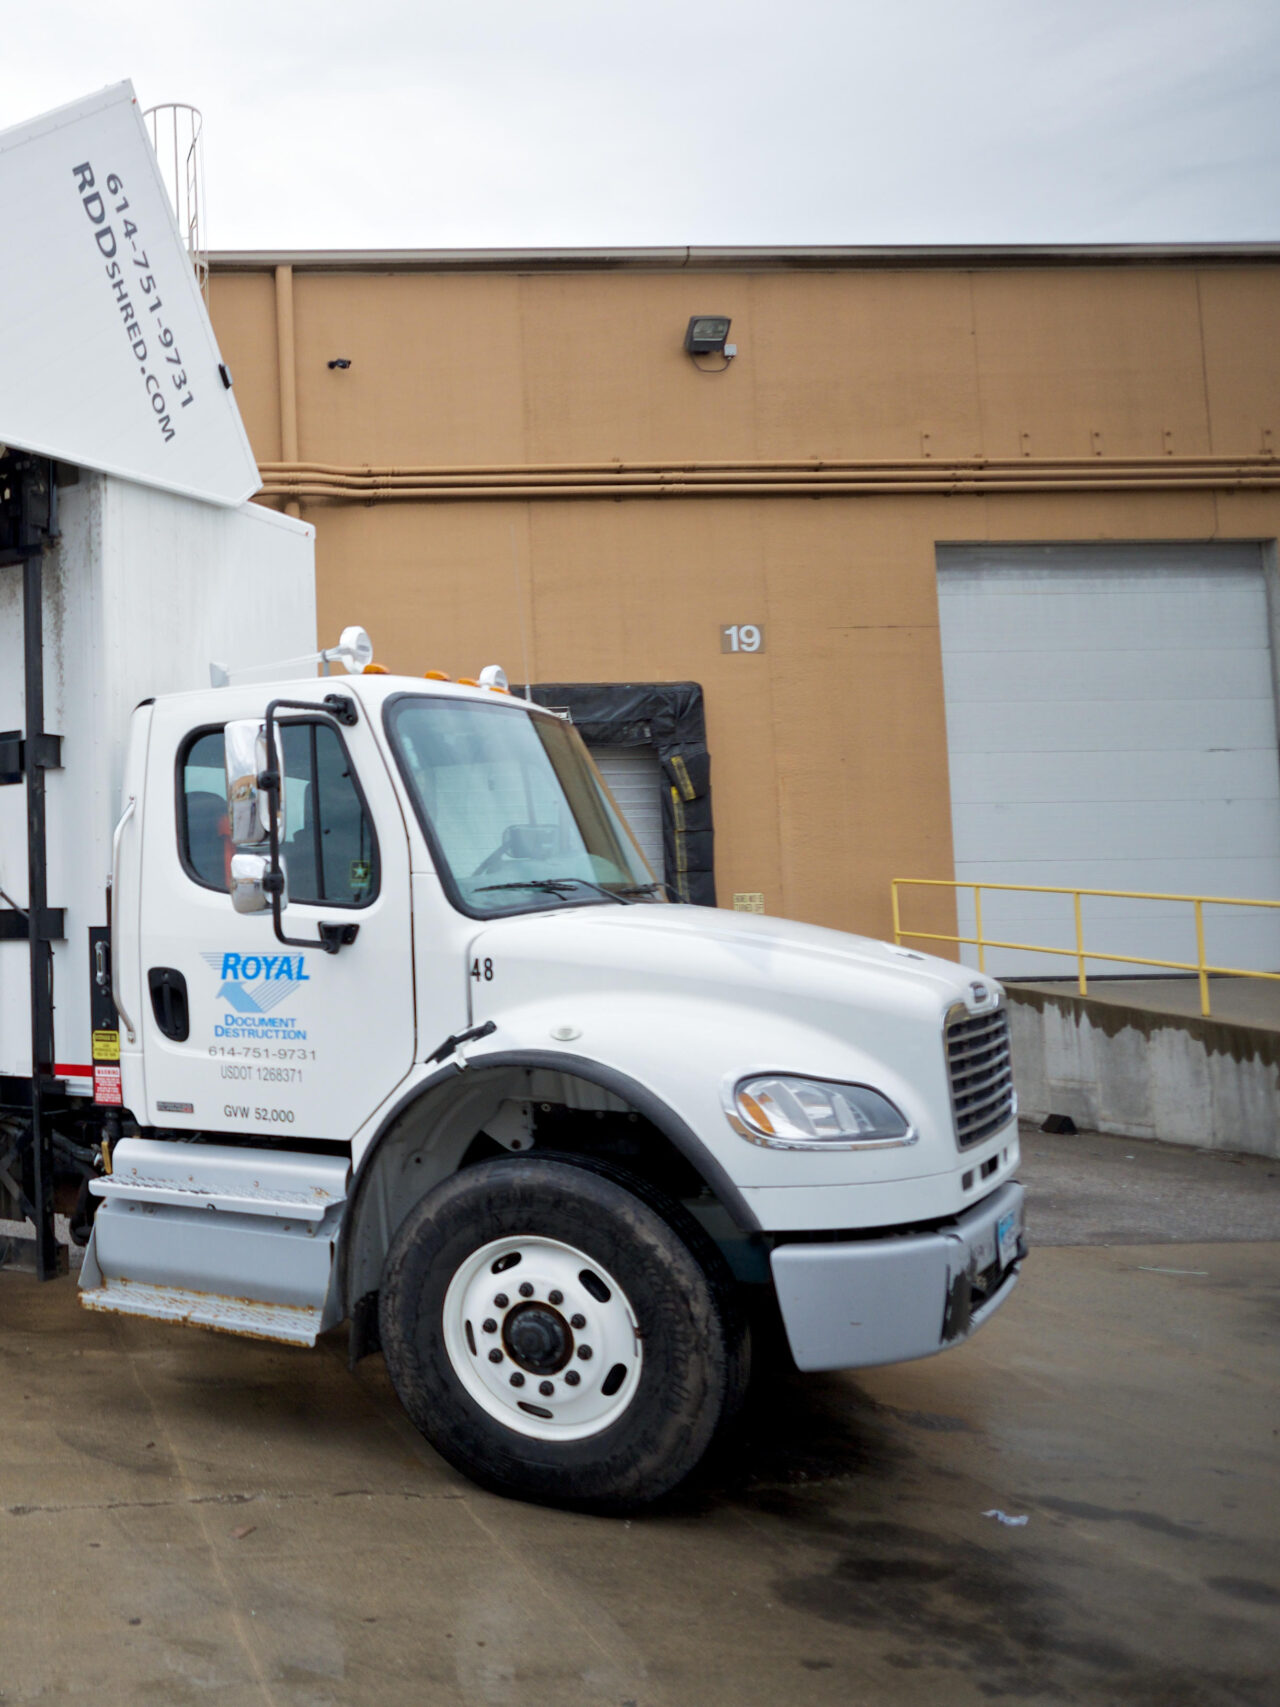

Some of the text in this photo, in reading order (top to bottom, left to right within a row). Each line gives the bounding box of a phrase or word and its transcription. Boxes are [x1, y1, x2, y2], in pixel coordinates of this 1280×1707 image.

[106, 173, 195, 407] 614-751-9731
[724, 625, 761, 652] 19
[221, 953, 310, 981] ROYAL
[470, 957, 493, 982] 48
[224, 1013, 297, 1028] DOCUMENT
[214, 1024, 307, 1041] DESTRUCTION
[208, 1046, 317, 1061] 614-751-9731
[220, 1065, 303, 1083] USDOT 1268371
[223, 1104, 295, 1123] GVW 52,000
